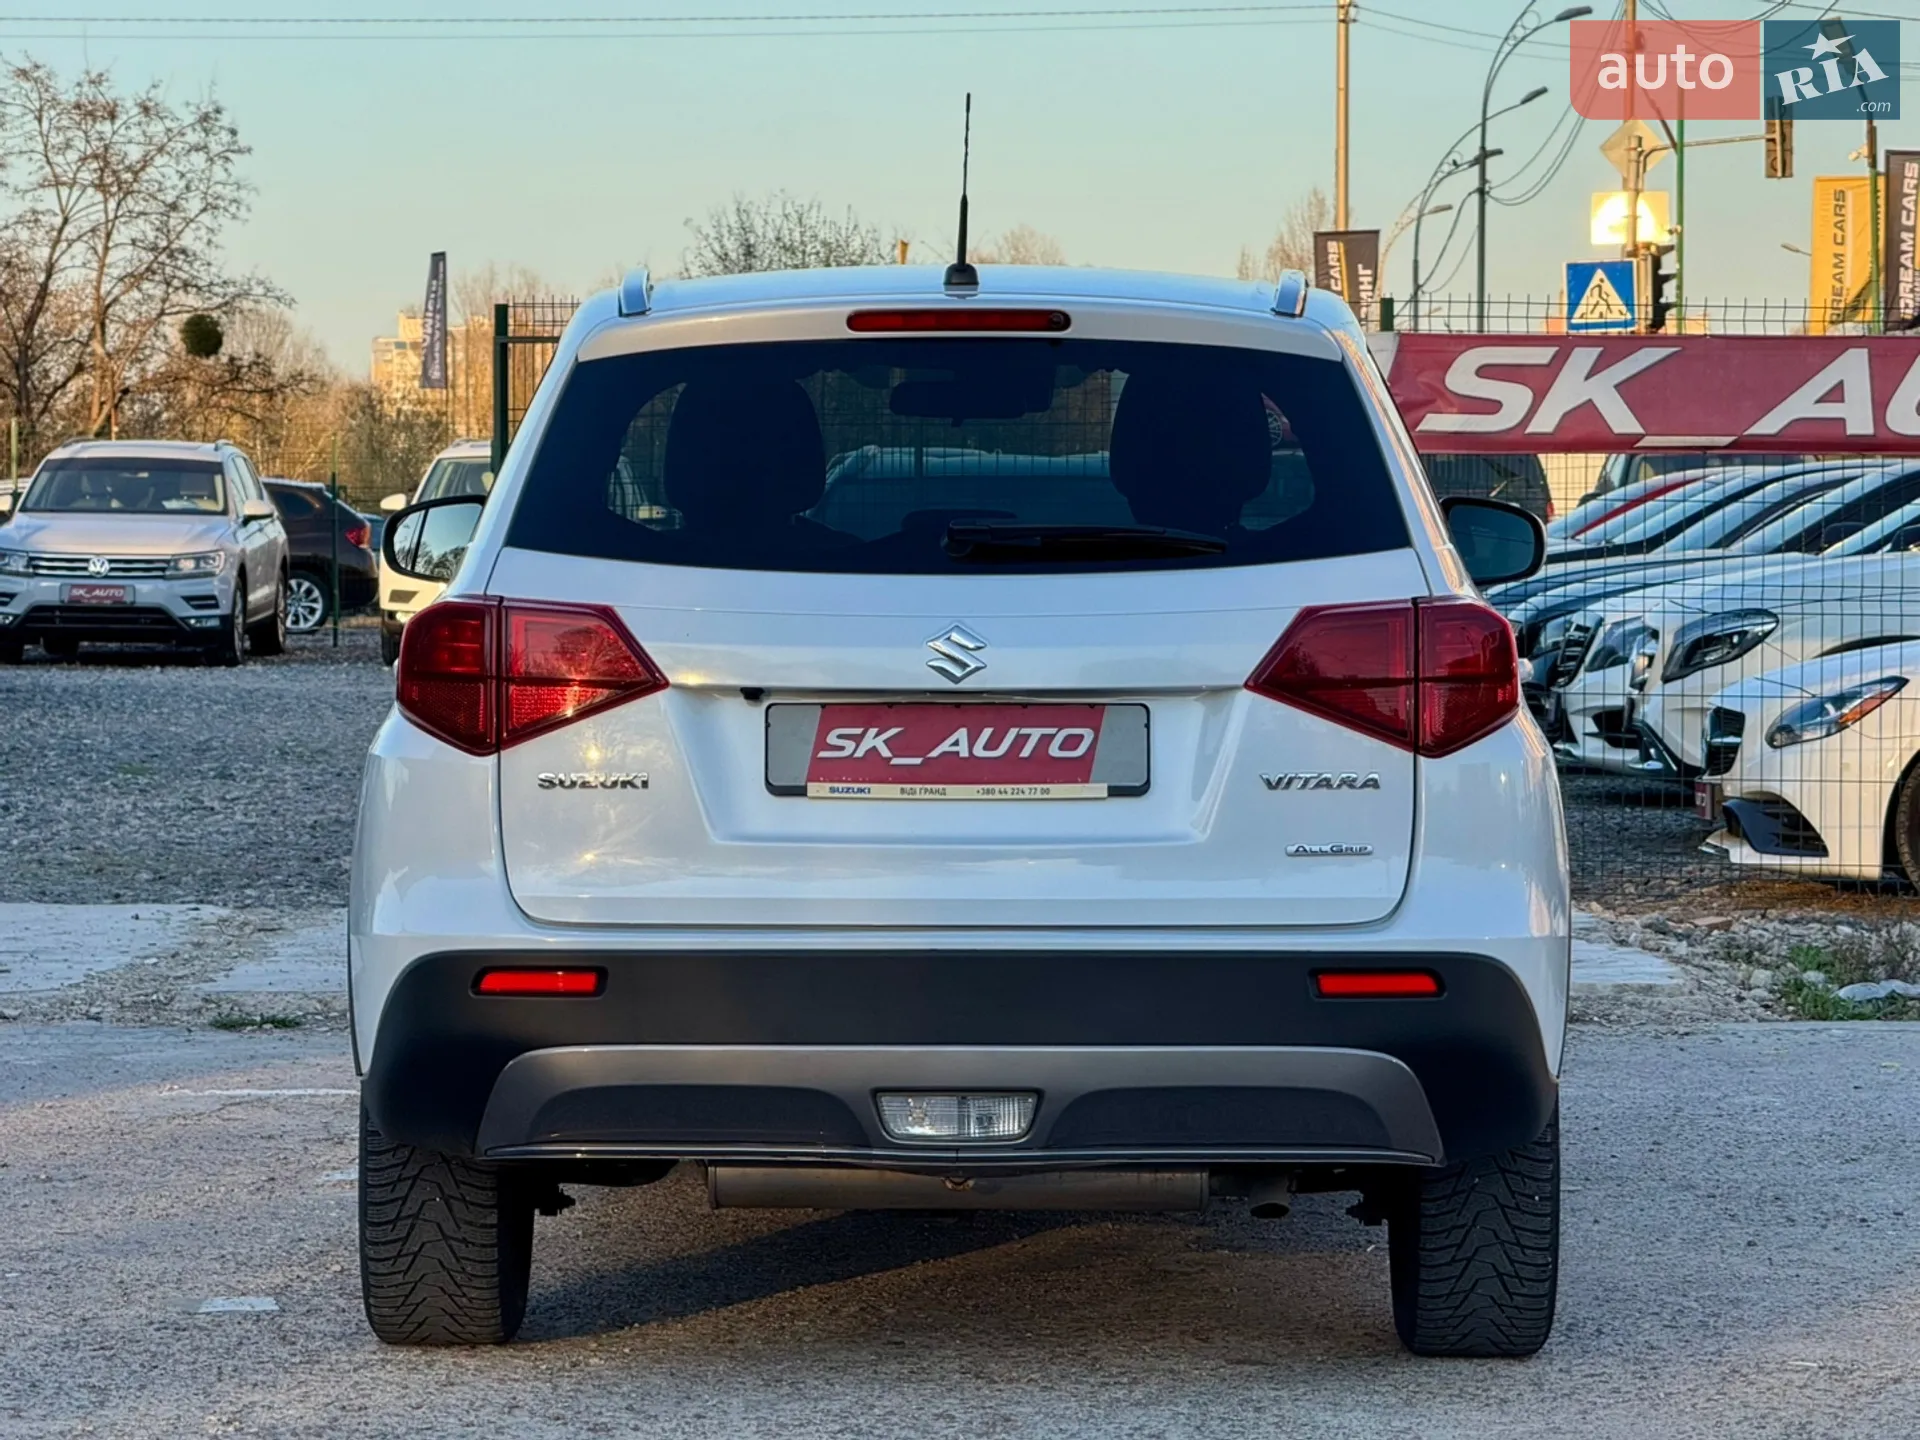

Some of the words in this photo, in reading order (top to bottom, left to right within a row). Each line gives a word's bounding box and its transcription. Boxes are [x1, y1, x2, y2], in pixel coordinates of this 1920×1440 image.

[1901, 161, 1919, 227] CARS
[1833, 188, 1846, 246] CARS
[1326, 240, 1342, 291] CARS
[1899, 231, 1916, 320] DREAM
[71, 587, 124, 598] SK_AUTO
[817, 727, 1094, 765] SK_AUTO
[537, 771, 649, 790] SUZUKI
[828, 786, 871, 796] SUZUKI
[976, 787, 996, 796] +380
[998, 787, 1008, 796] 44
[1010, 787, 1025, 796] 224
[1027, 787, 1038, 796] 77
[1040, 787, 1050, 796] 00
[1259, 771, 1381, 791] VITARA
